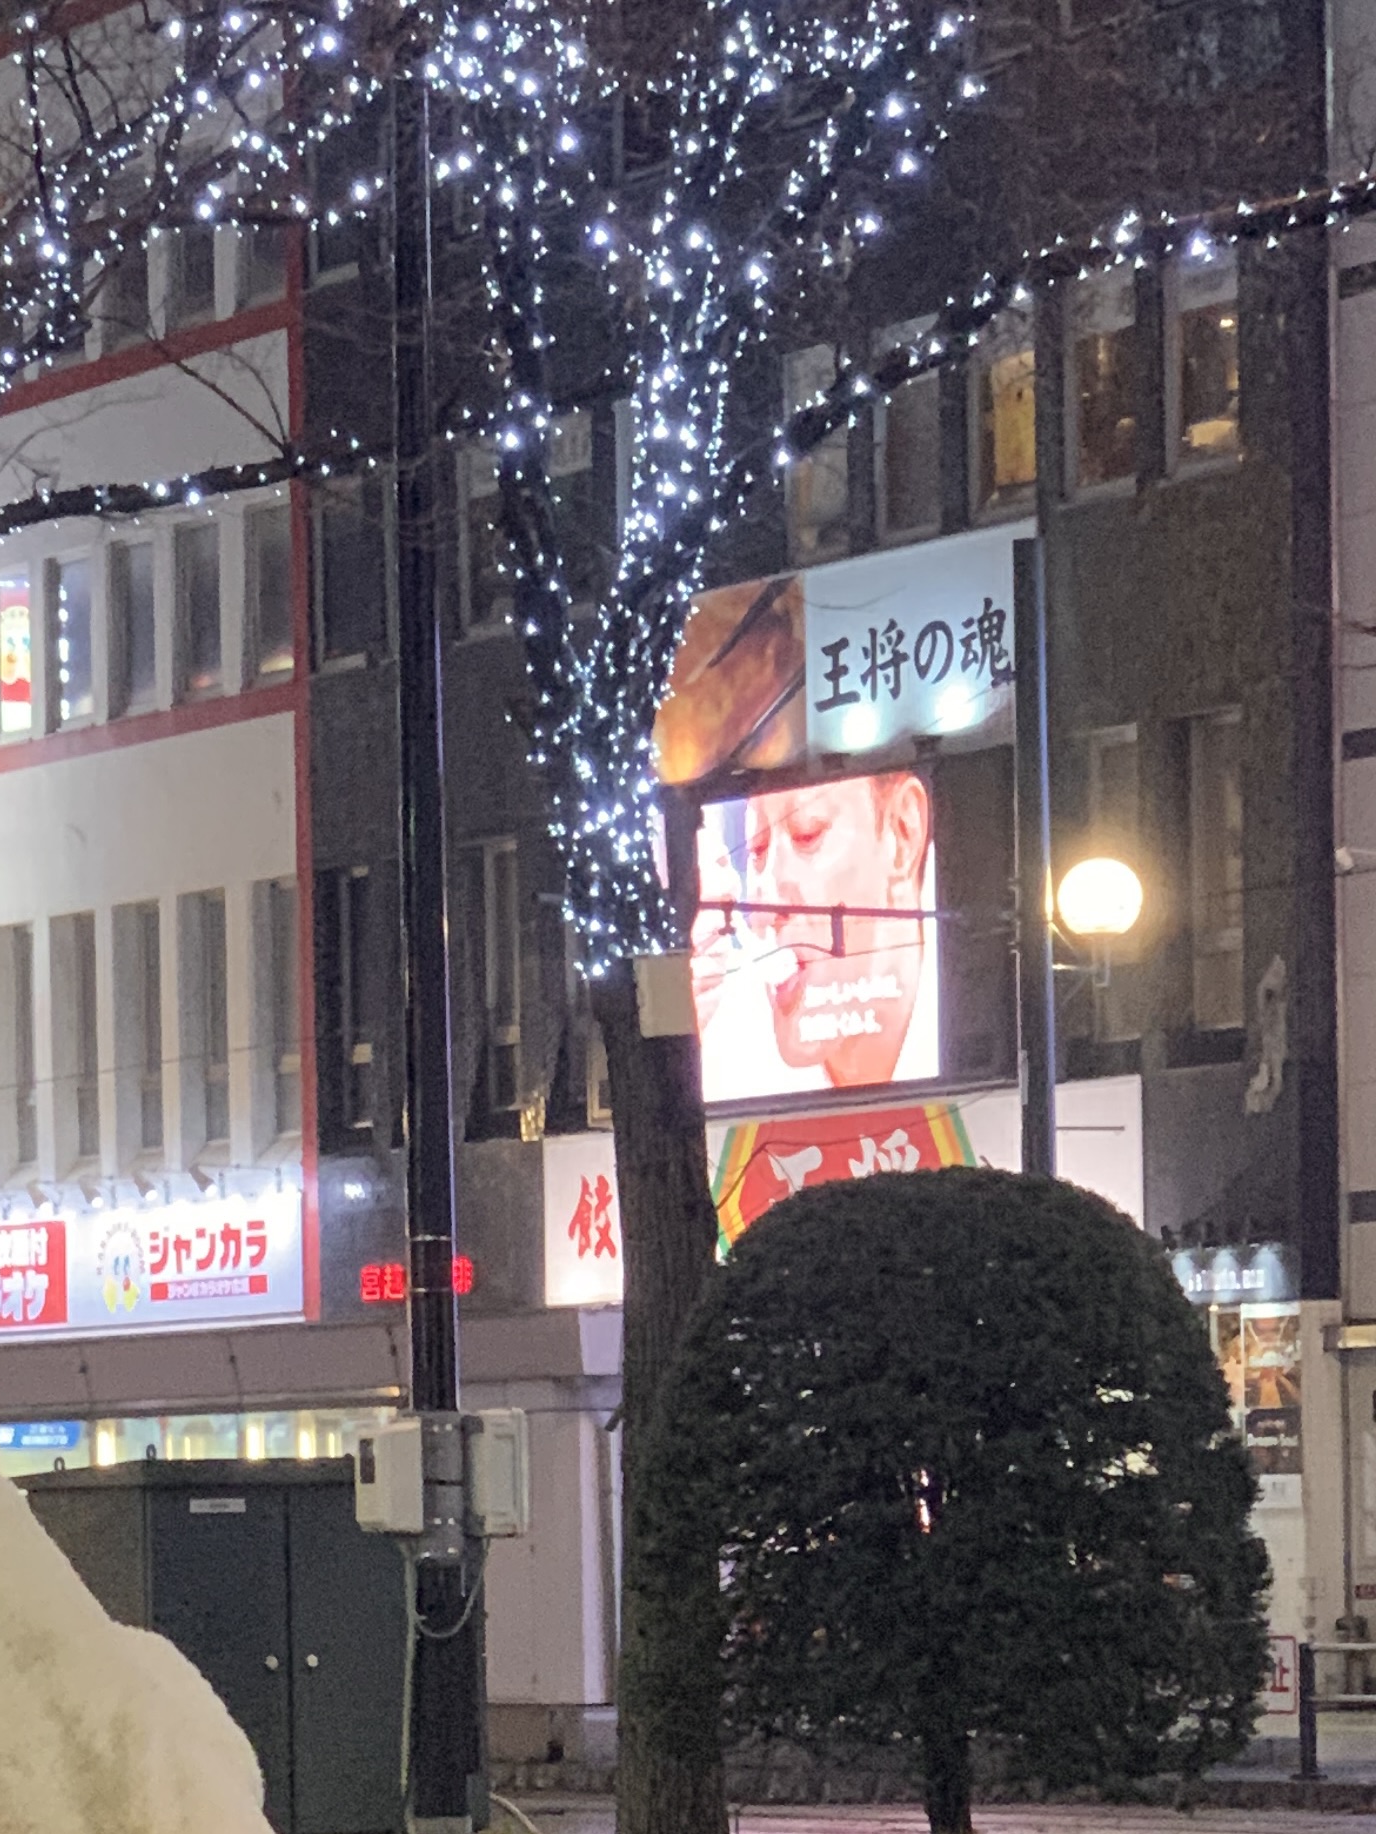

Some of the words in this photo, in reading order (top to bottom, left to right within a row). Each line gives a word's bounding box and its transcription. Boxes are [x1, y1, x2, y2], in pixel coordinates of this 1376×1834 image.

[814, 597, 1015, 712] 王将の魂
[149, 1220, 267, 1276] ジャンカラ
[567, 1173, 617, 1259] 餃
